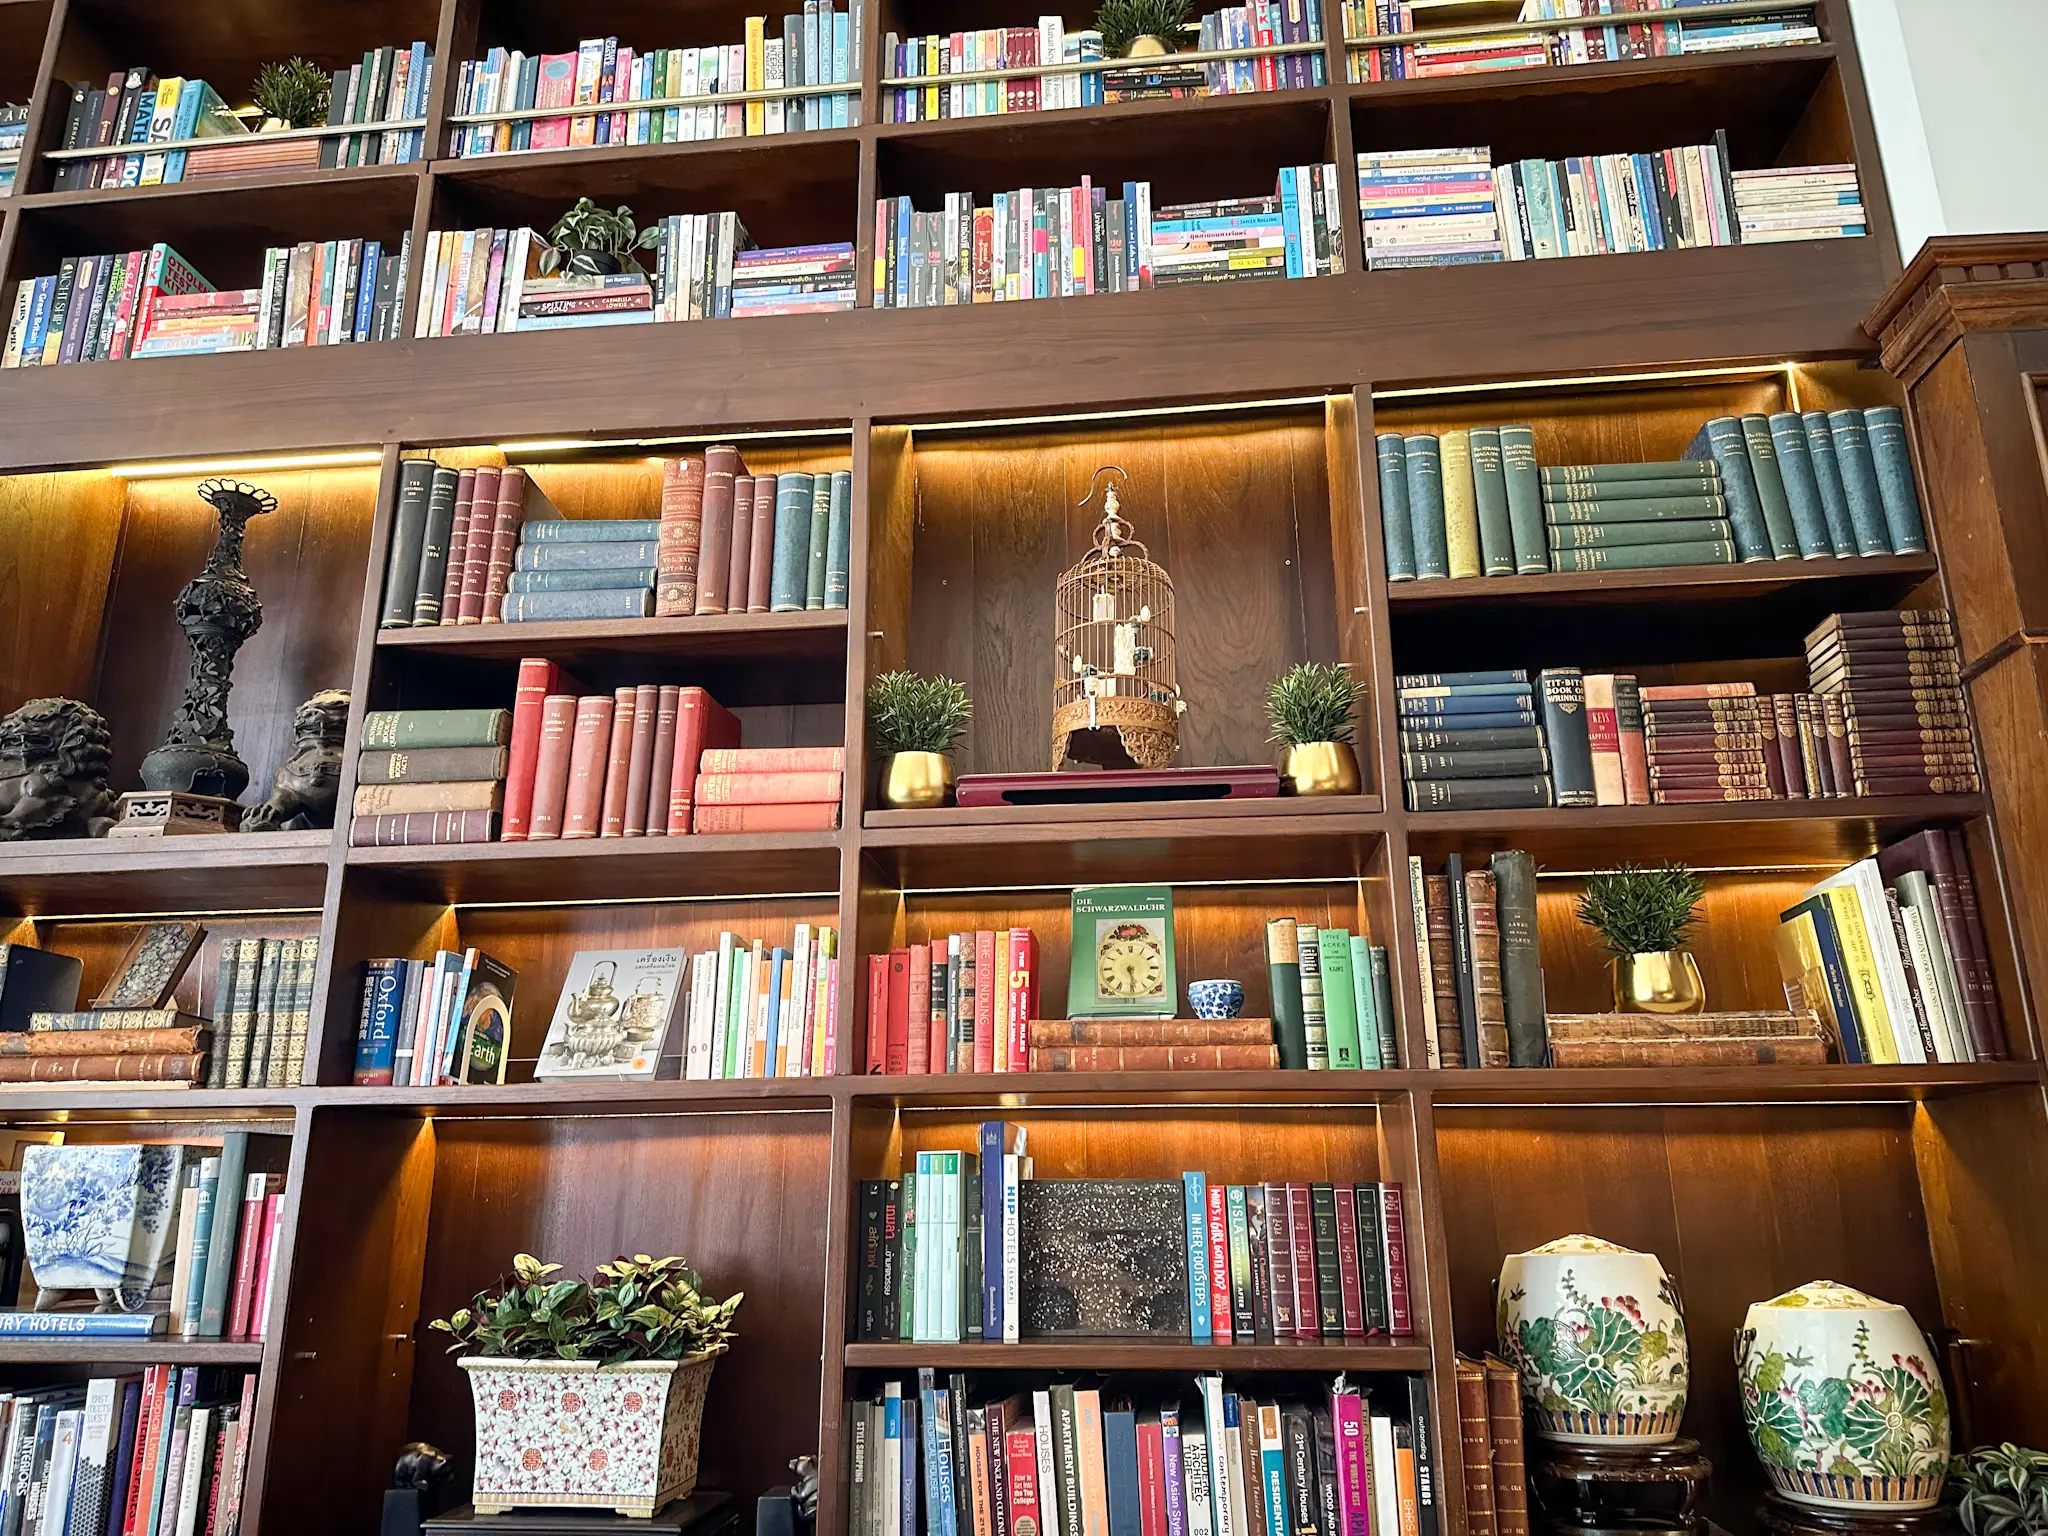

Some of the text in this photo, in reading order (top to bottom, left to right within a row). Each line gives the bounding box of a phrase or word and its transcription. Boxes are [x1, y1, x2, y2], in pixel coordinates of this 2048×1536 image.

[769, 44, 777, 81] INTERIOR
[108, 258, 122, 301] PATTERSON
[116, 268, 126, 292] JAMES
[165, 268, 192, 292] TEST
[1253, 269, 1279, 277] HOFFMAN
[30, 292, 47, 344] Great Britain
[53, 269, 73, 325] NIGHT SHIP
[541, 299, 576, 311] SPITTING
[547, 305, 569, 315] GOLD
[1546, 686, 1573, 695] BOOK
[1591, 711, 1610, 723] KEYS
[1076, 898, 1093, 906] DIE
[1076, 903, 1166, 913] SCHWARZWALDUHR
[636, 953, 677, 964] เครื่องเงิน
[1008, 969, 1030, 989] 5
[979, 938, 991, 1026] THE FOUNDLING
[373, 975, 397, 1040] Oxford
[815, 984, 826, 1029] Earth Science
[996, 950, 1007, 1062] GENTLE CONQUISTADORS
[1009, 991, 1017, 1044] OF SELLING
[1018, 991, 1027, 1053] GREAT RULES
[1911, 987, 1934, 1053] Georg Himmelheber
[1006, 1185, 1016, 1264] HIP HOTELS
[1210, 1221, 1224, 1244] GIRL
[1232, 1205, 1243, 1235] ISLA
[1191, 1213, 1207, 1307] IN HER FOOTSTEPS
[1213, 1269, 1227, 1291] DO?
[29, 1318, 86, 1331] HOTELS
[1221, 1294, 1230, 1315] HOLLY
[183, 1383, 192, 1397] 2
[62, 1431, 73, 1445] 4
[143, 1391, 165, 1471] Tropical Living
[855, 1421, 866, 1484] STYLE SHOPPING
[954, 1389, 967, 1478] indonesian architecture now
[1038, 1424, 1052, 1475] HOUSES
[1363, 1433, 1371, 1458] NEW
[16, 1436, 34, 1497] INTERIORS
[167, 1450, 182, 1487] CHINA
[188, 1437, 199, 1481] GARDEN
[926, 1415, 939, 1500] TROPICAL HOUSES
[937, 1437, 954, 1503] Houses
[975, 1445, 983, 1478] HOUSES
[991, 1416, 1005, 1501] THE NEW ENGLAND
[1060, 1408, 1080, 1536] APARTMENT BUILDINGS
[1183, 1444, 1193, 1475] TURE
[1190, 1443, 1204, 1507] ARCHITEC-
[1246, 1414, 1263, 1520] Heritage Homes of Thailand
[1295, 1433, 1310, 1524] 21st Century Houses
[1342, 1420, 1361, 1507] 50 OF THE WORLD'S BEST
[1418, 1415, 1432, 1507] outstanding STANDS
[27, 1481, 41, 1520] HOUSES
[127, 1469, 141, 1519] SPACES
[184, 1482, 192, 1510] STYLE
[205, 1431, 226, 1536] IN THE ORIENTAL
[1013, 1496, 1036, 1505] Colleges
[1023, 1490, 1034, 1498] Top
[1168, 1454, 1183, 1536] New Asian Style
[1216, 1455, 1231, 1535] contemporary
[1366, 1463, 1374, 1498] HOTEL
[1324, 1483, 1335, 1530] WOOD AND
[1402, 1498, 1415, 1532] BARS
[1194, 1528, 1209, 1536] 002
